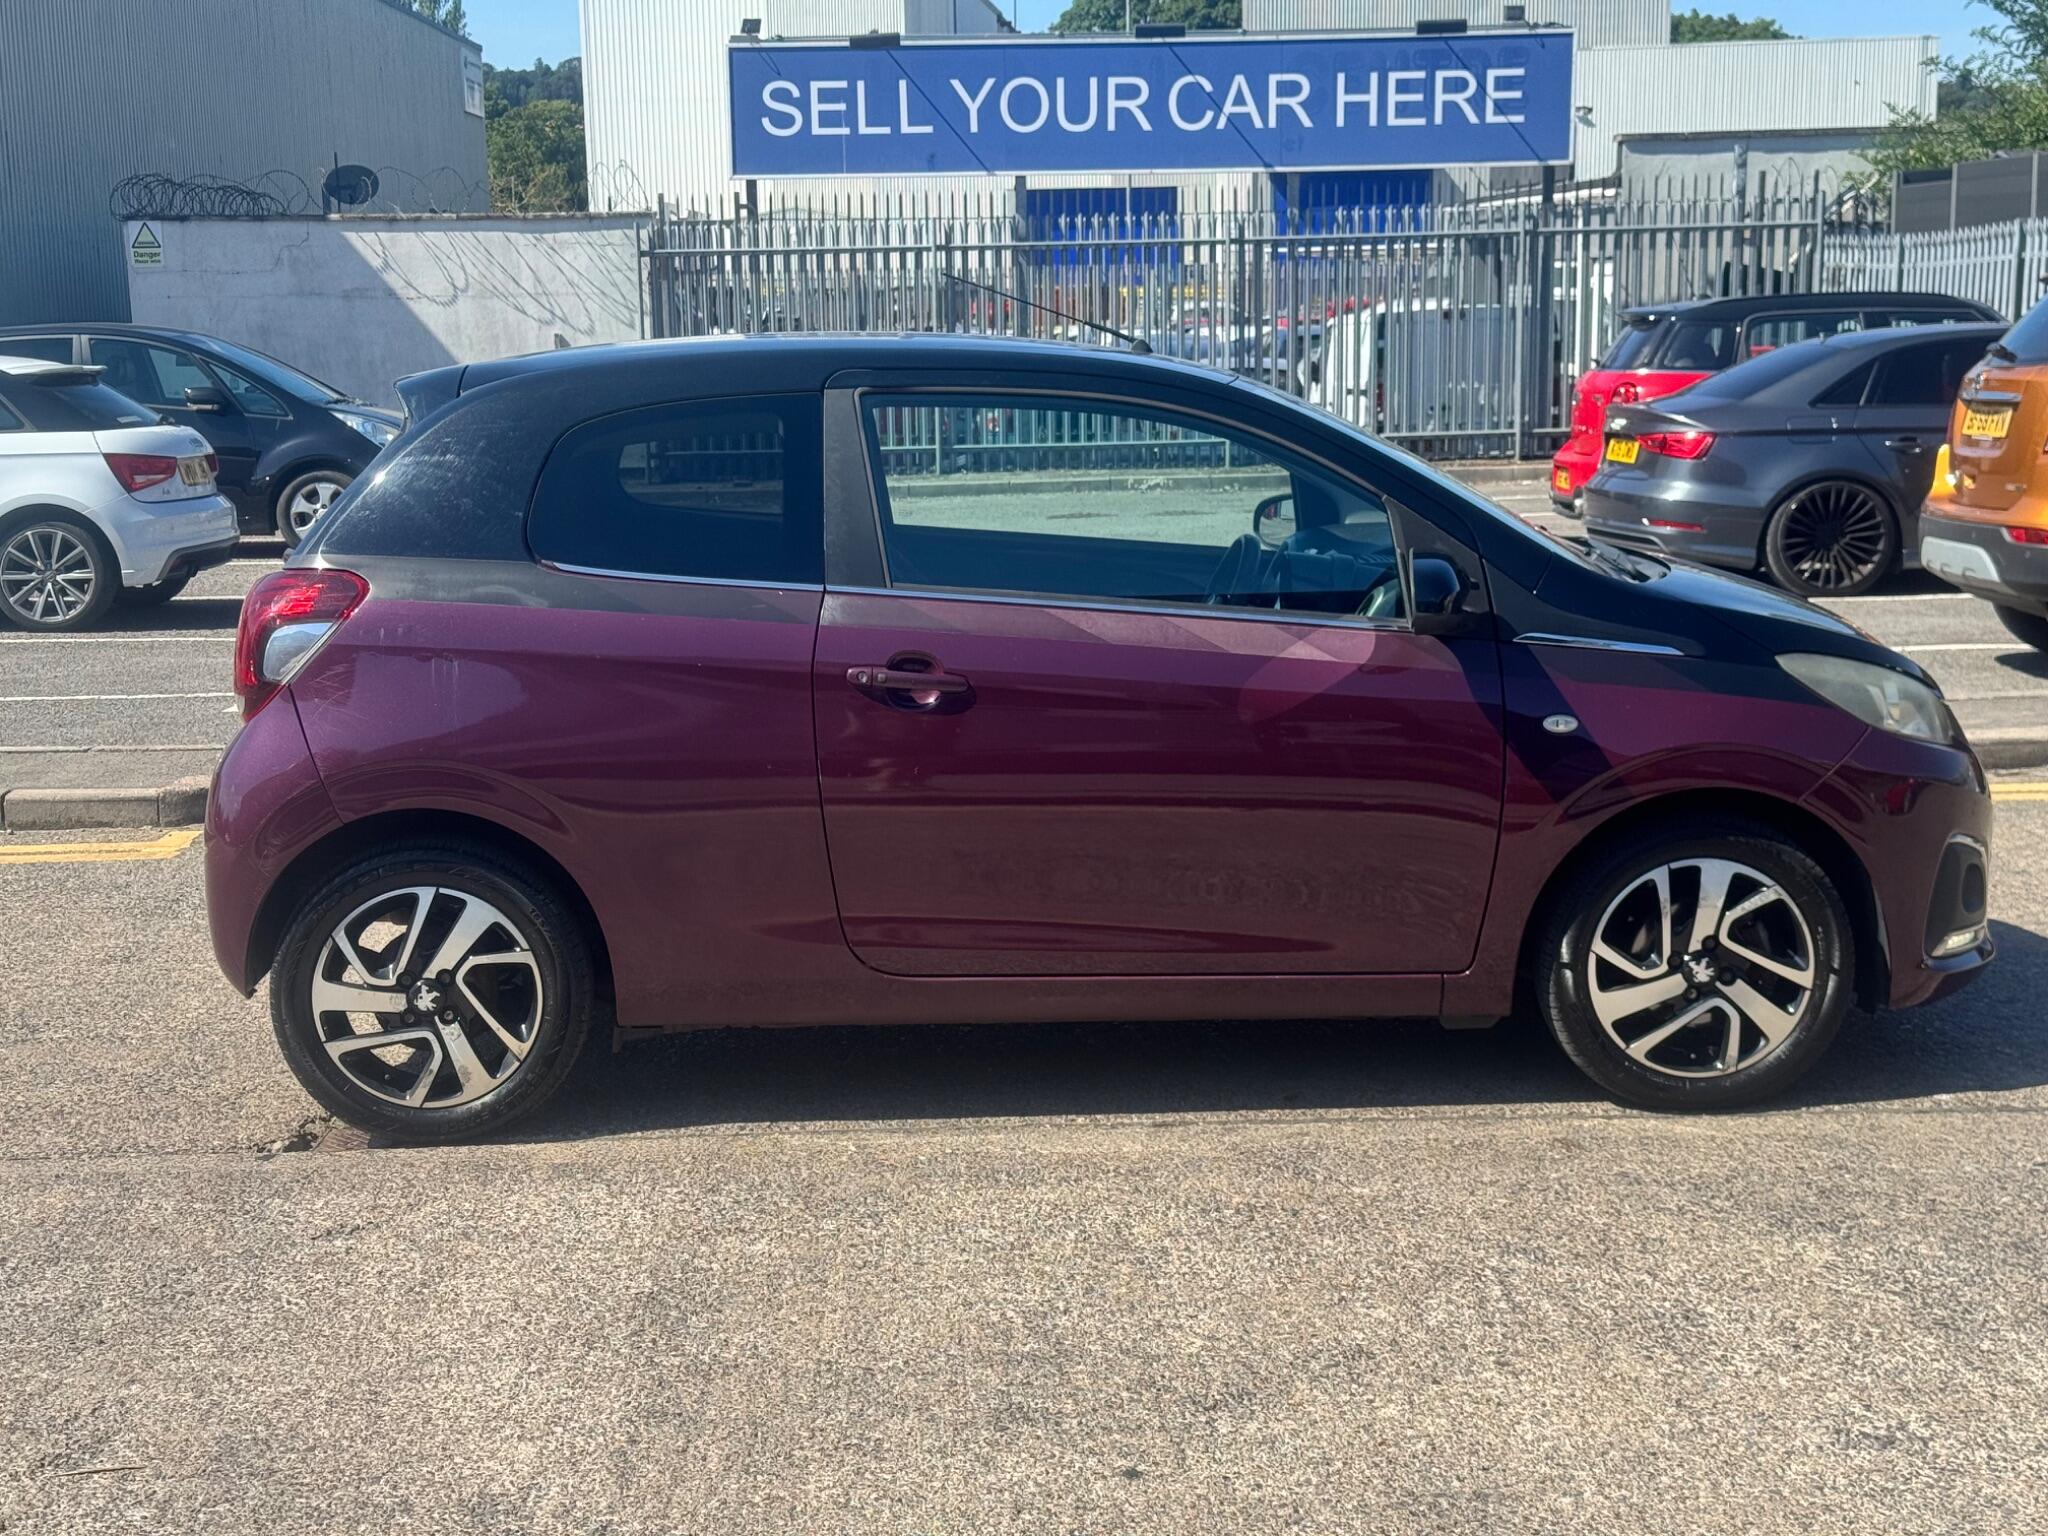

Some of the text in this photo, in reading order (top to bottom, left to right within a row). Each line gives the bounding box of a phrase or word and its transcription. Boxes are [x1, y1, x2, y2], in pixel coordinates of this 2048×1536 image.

[760, 67, 1527, 138] SELL YOUR CAR HERE
[133, 250, 161, 260] Danger
